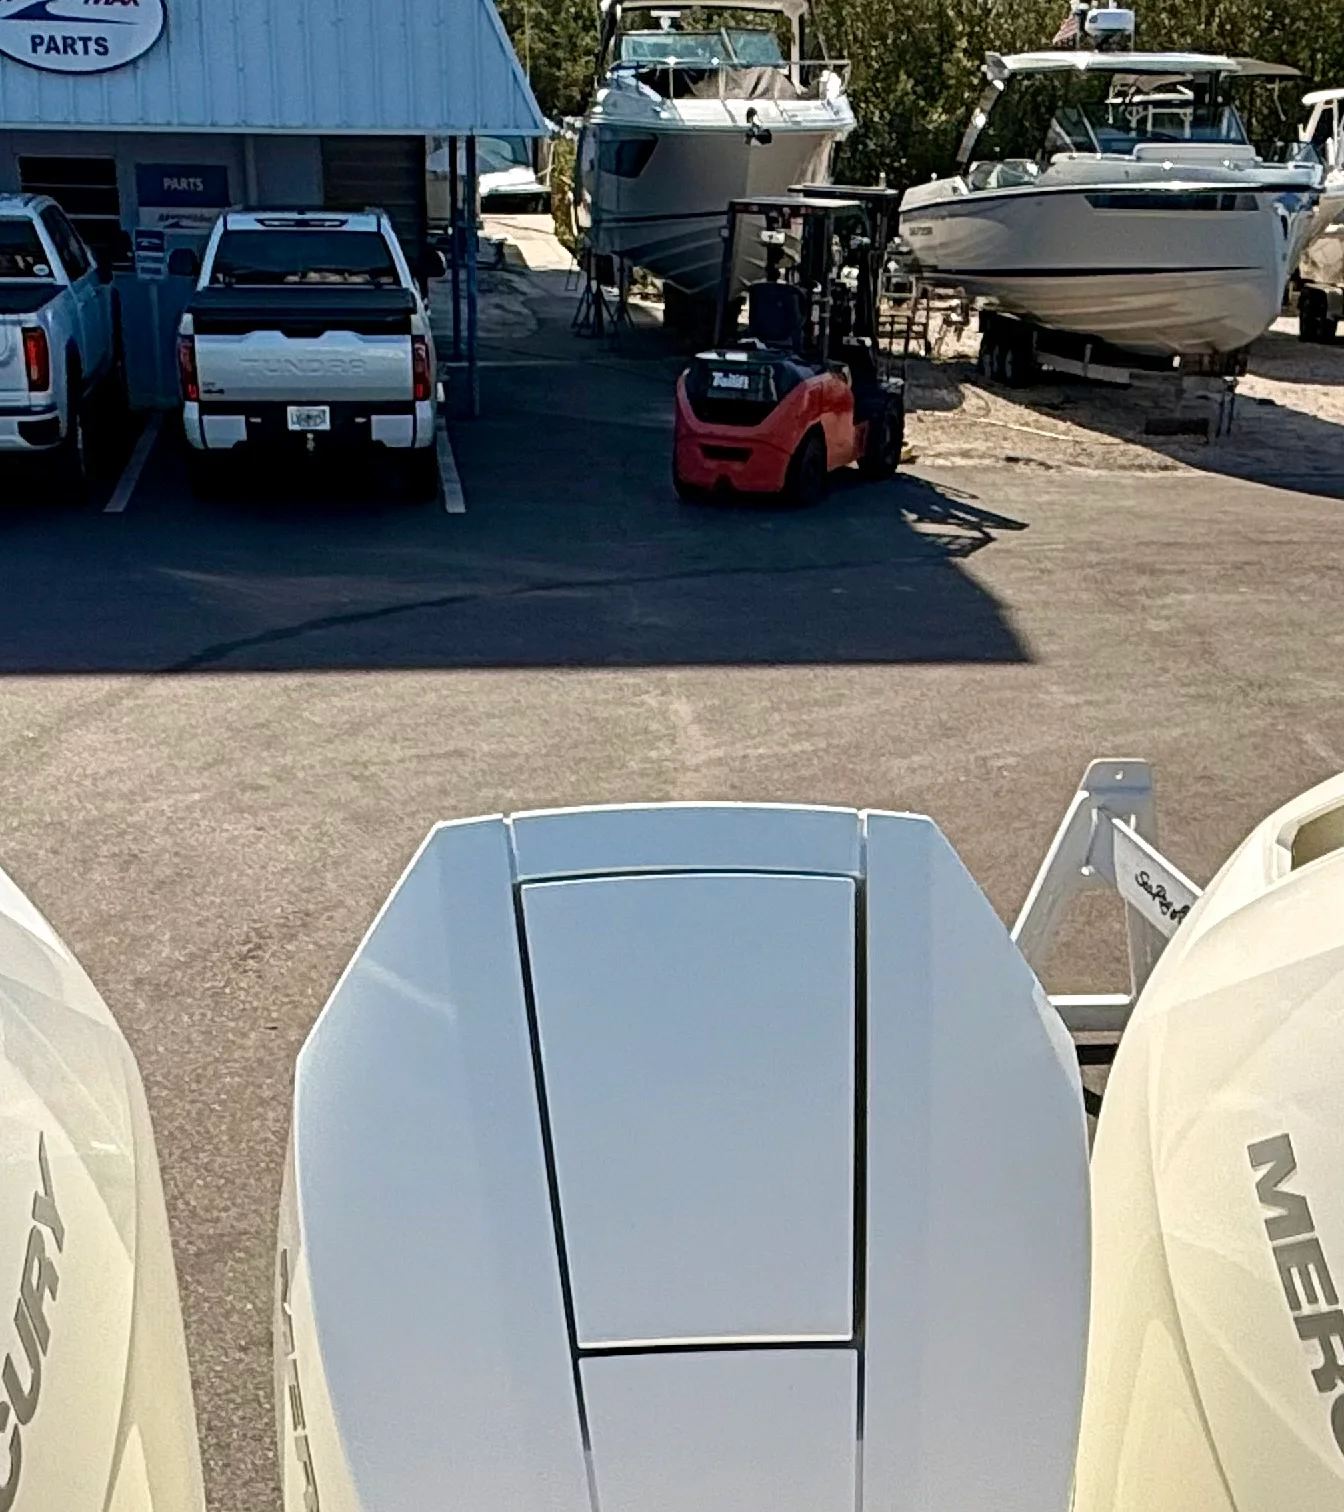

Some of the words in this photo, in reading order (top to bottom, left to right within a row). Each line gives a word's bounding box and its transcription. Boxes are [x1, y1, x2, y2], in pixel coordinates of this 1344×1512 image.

[30, 34, 110, 56] PARTS
[162, 176, 204, 192] PARTS
[240, 358, 367, 376] TUNDRA
